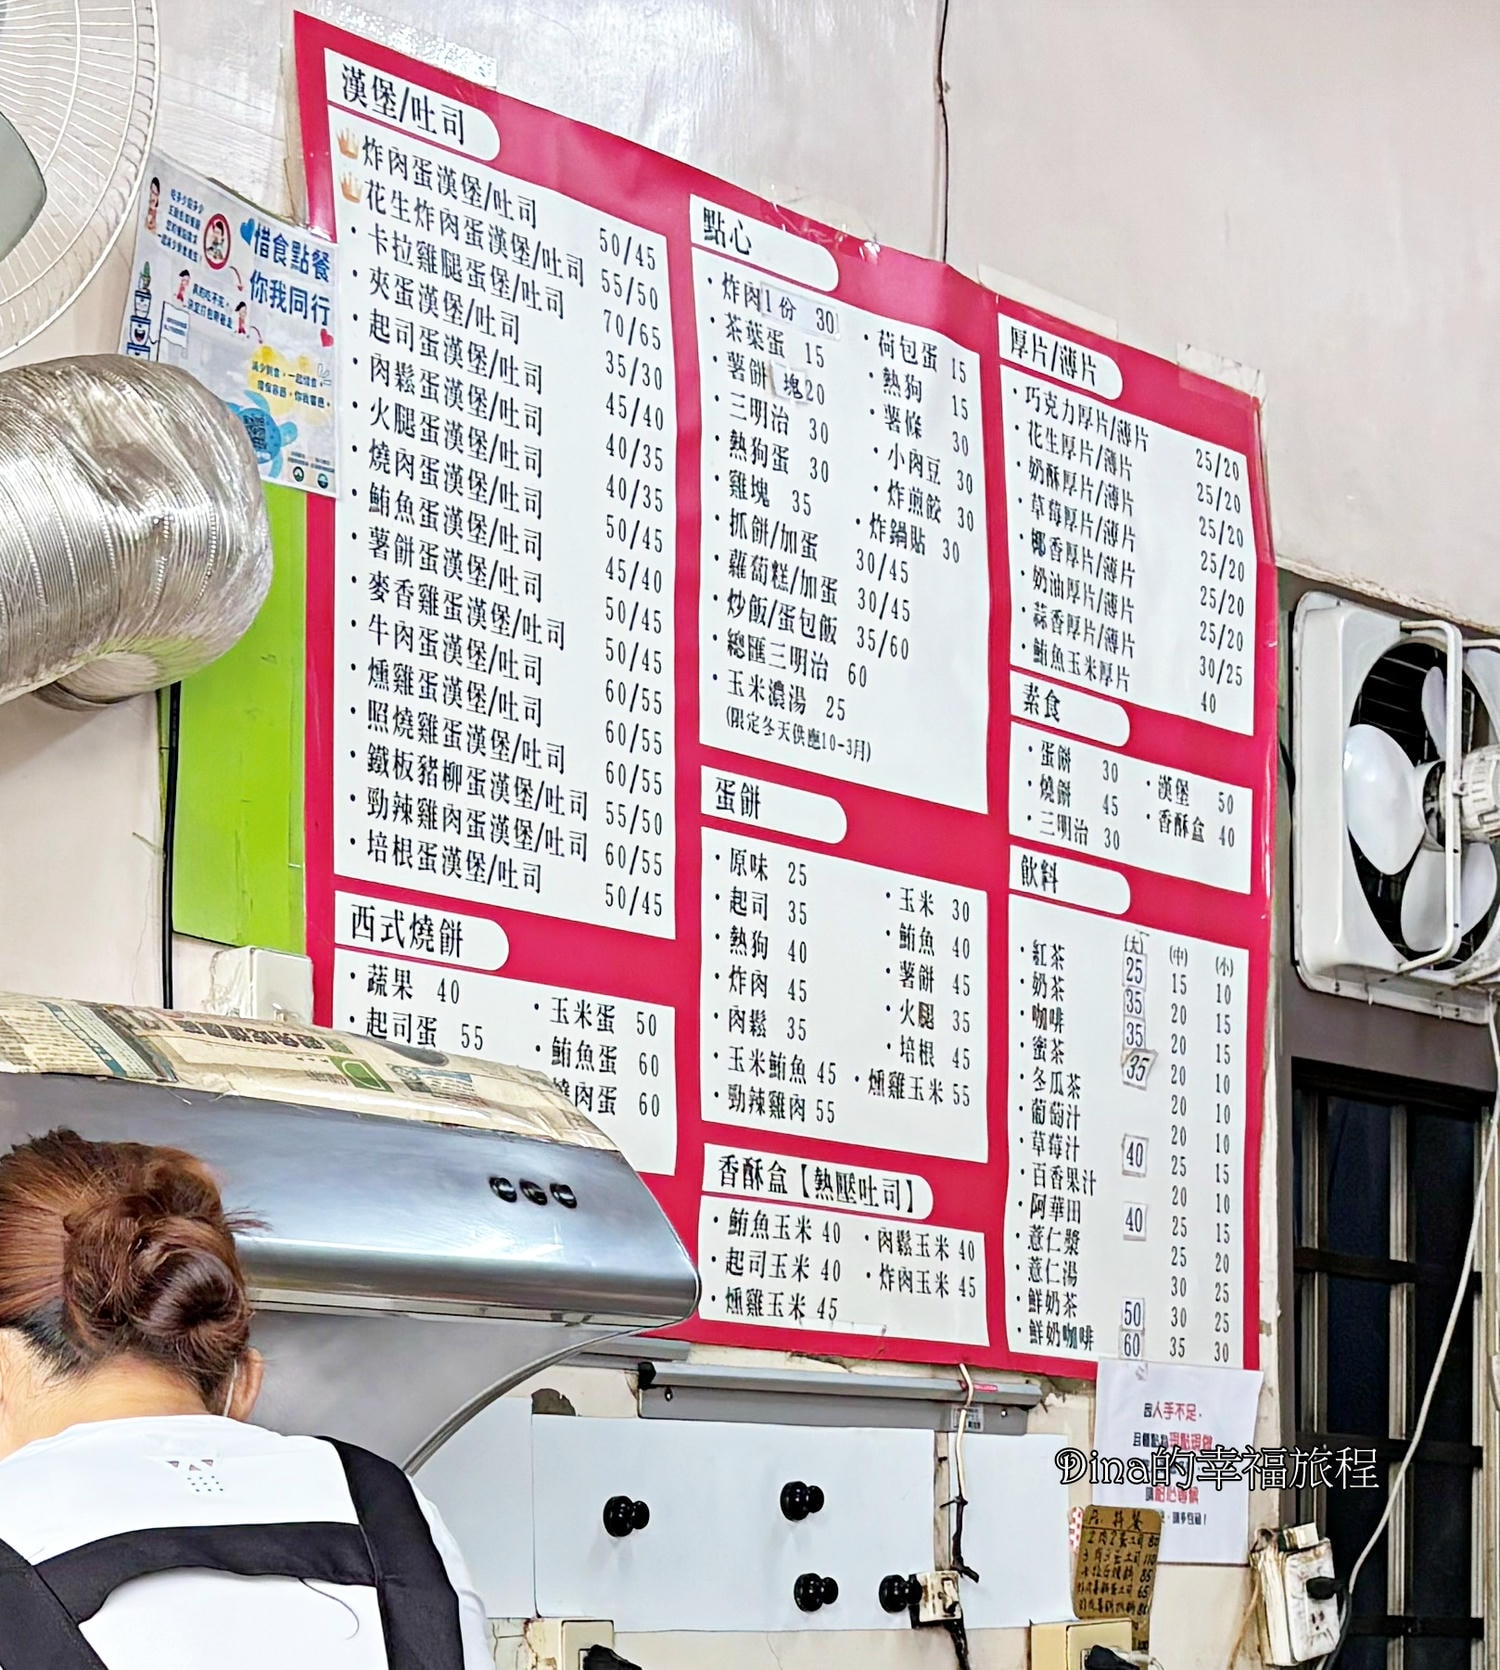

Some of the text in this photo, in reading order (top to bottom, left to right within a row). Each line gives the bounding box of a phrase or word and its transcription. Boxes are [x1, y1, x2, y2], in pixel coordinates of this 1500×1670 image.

[342, 63, 466, 147] 漢堡/吐司
[362, 135, 656, 271] 炸肉蛋漢堡/吐司 50/45
[253, 222, 332, 285] 惜食點餐
[364, 179, 658, 311] 花生炸肉蛋漢堡/吐司 55/50
[703, 207, 752, 256] 點心
[250, 270, 332, 328] 你我同行
[368, 222, 661, 351] 卡拉雞腿蛋堡/吐司 70/65
[369, 266, 662, 391] 夾蛋漢堡/吐司 35/30
[724, 312, 824, 368] 茶葉蛋 15
[369, 308, 542, 396] 起司蛋漢堡/吐司
[605, 391, 664, 431] 45/40
[878, 329, 966, 384] 荷包蛋 15
[1011, 326, 1098, 387] 厚片/薄片
[730, 392, 829, 445] 三明治 30
[883, 366, 968, 421] 熱狗 15
[370, 396, 663, 513] 火腿蛋漢堡/吐司 40/35
[952, 431, 969, 457] 30
[1025, 386, 1239, 481] 巧克力厚片/薄片 25/20
[729, 469, 811, 516] 雞塊 35
[887, 442, 973, 495] 小肉豆 30
[1027, 419, 1241, 514] 花生厚片/薄片 25/20
[368, 438, 663, 553] 燒肉蛋漢堡/吐司 50/45
[368, 481, 662, 594] 鮪魚蛋漢堡/吐司 45/40
[729, 507, 908, 584] 抓餅/加蛋 30/45
[1199, 515, 1244, 548] 25/20
[727, 587, 909, 660] 炒飯/蛋包飯 35/60
[1032, 564, 1243, 652] 奶油厚片/薄片 25/20
[368, 613, 662, 715] 牛肉蛋漢堡/吐司 60/55
[728, 669, 845, 721] 玉米濃湯 25
[1022, 682, 1062, 723] 素食
[1201, 691, 1216, 714] 40
[367, 699, 662, 796] 照燒雞蛋漢堡/吐司 60/55
[716, 777, 762, 820] 蛋餅
[1102, 794, 1118, 817] 45
[1158, 775, 1234, 815] 漢堡 50
[1040, 811, 1120, 851] 三明治 30
[1159, 809, 1235, 848] 香酥盒 40
[367, 828, 662, 917] 培根蛋漢堡/吐司 50/45
[730, 847, 807, 887] 原味 25
[1021, 854, 1060, 894] 飲料
[729, 885, 807, 926] 起司 35
[899, 887, 970, 923] 玉米 30
[351, 904, 464, 960] 西式燒餅
[899, 922, 970, 960] 鮪魚 40
[367, 963, 460, 1005] 蔬果 40
[728, 964, 807, 1003] 炸肉 45
[1032, 939, 1231, 1005] 紅茶 25 15 10
[1169, 945, 1188, 967] (中)
[1215, 956, 1234, 978] (小)
[366, 1006, 438, 1048] 起司蛋
[461, 1023, 483, 1051] 55
[550, 997, 657, 1037] 玉米蛋 50
[728, 1005, 806, 1041] 肉鬆 35
[1032, 970, 1231, 1035] 奶茶 35 20 15
[551, 1035, 659, 1077] 鮪魚蛋 60
[900, 1034, 970, 1070] 培根 45
[1032, 1002, 1231, 1065] 咖啡 35 20 15
[728, 1046, 836, 1085] 玉米鮪魚 45
[1126, 1056, 1150, 1082] 35
[1171, 1064, 1186, 1086] 20
[1216, 1073, 1230, 1095] 10
[728, 1083, 835, 1124] 勁辣雞肉 55
[1032, 1129, 1229, 1185] 草莓汁 40 25 15
[1032, 1162, 1230, 1214] 百香果汁 20 10
[727, 1207, 841, 1244] 鮪魚玉米 40
[1030, 1192, 1230, 1244] 阿華田 40 25 15
[725, 1246, 841, 1283] 起司玉米 40
[879, 1262, 976, 1299] 炸肉玉米 45
[1028, 1287, 1229, 1333] 鮮奶茶 50 30 25
[1029, 1318, 1229, 1363] 鮮奶咖啡 60 35 30
